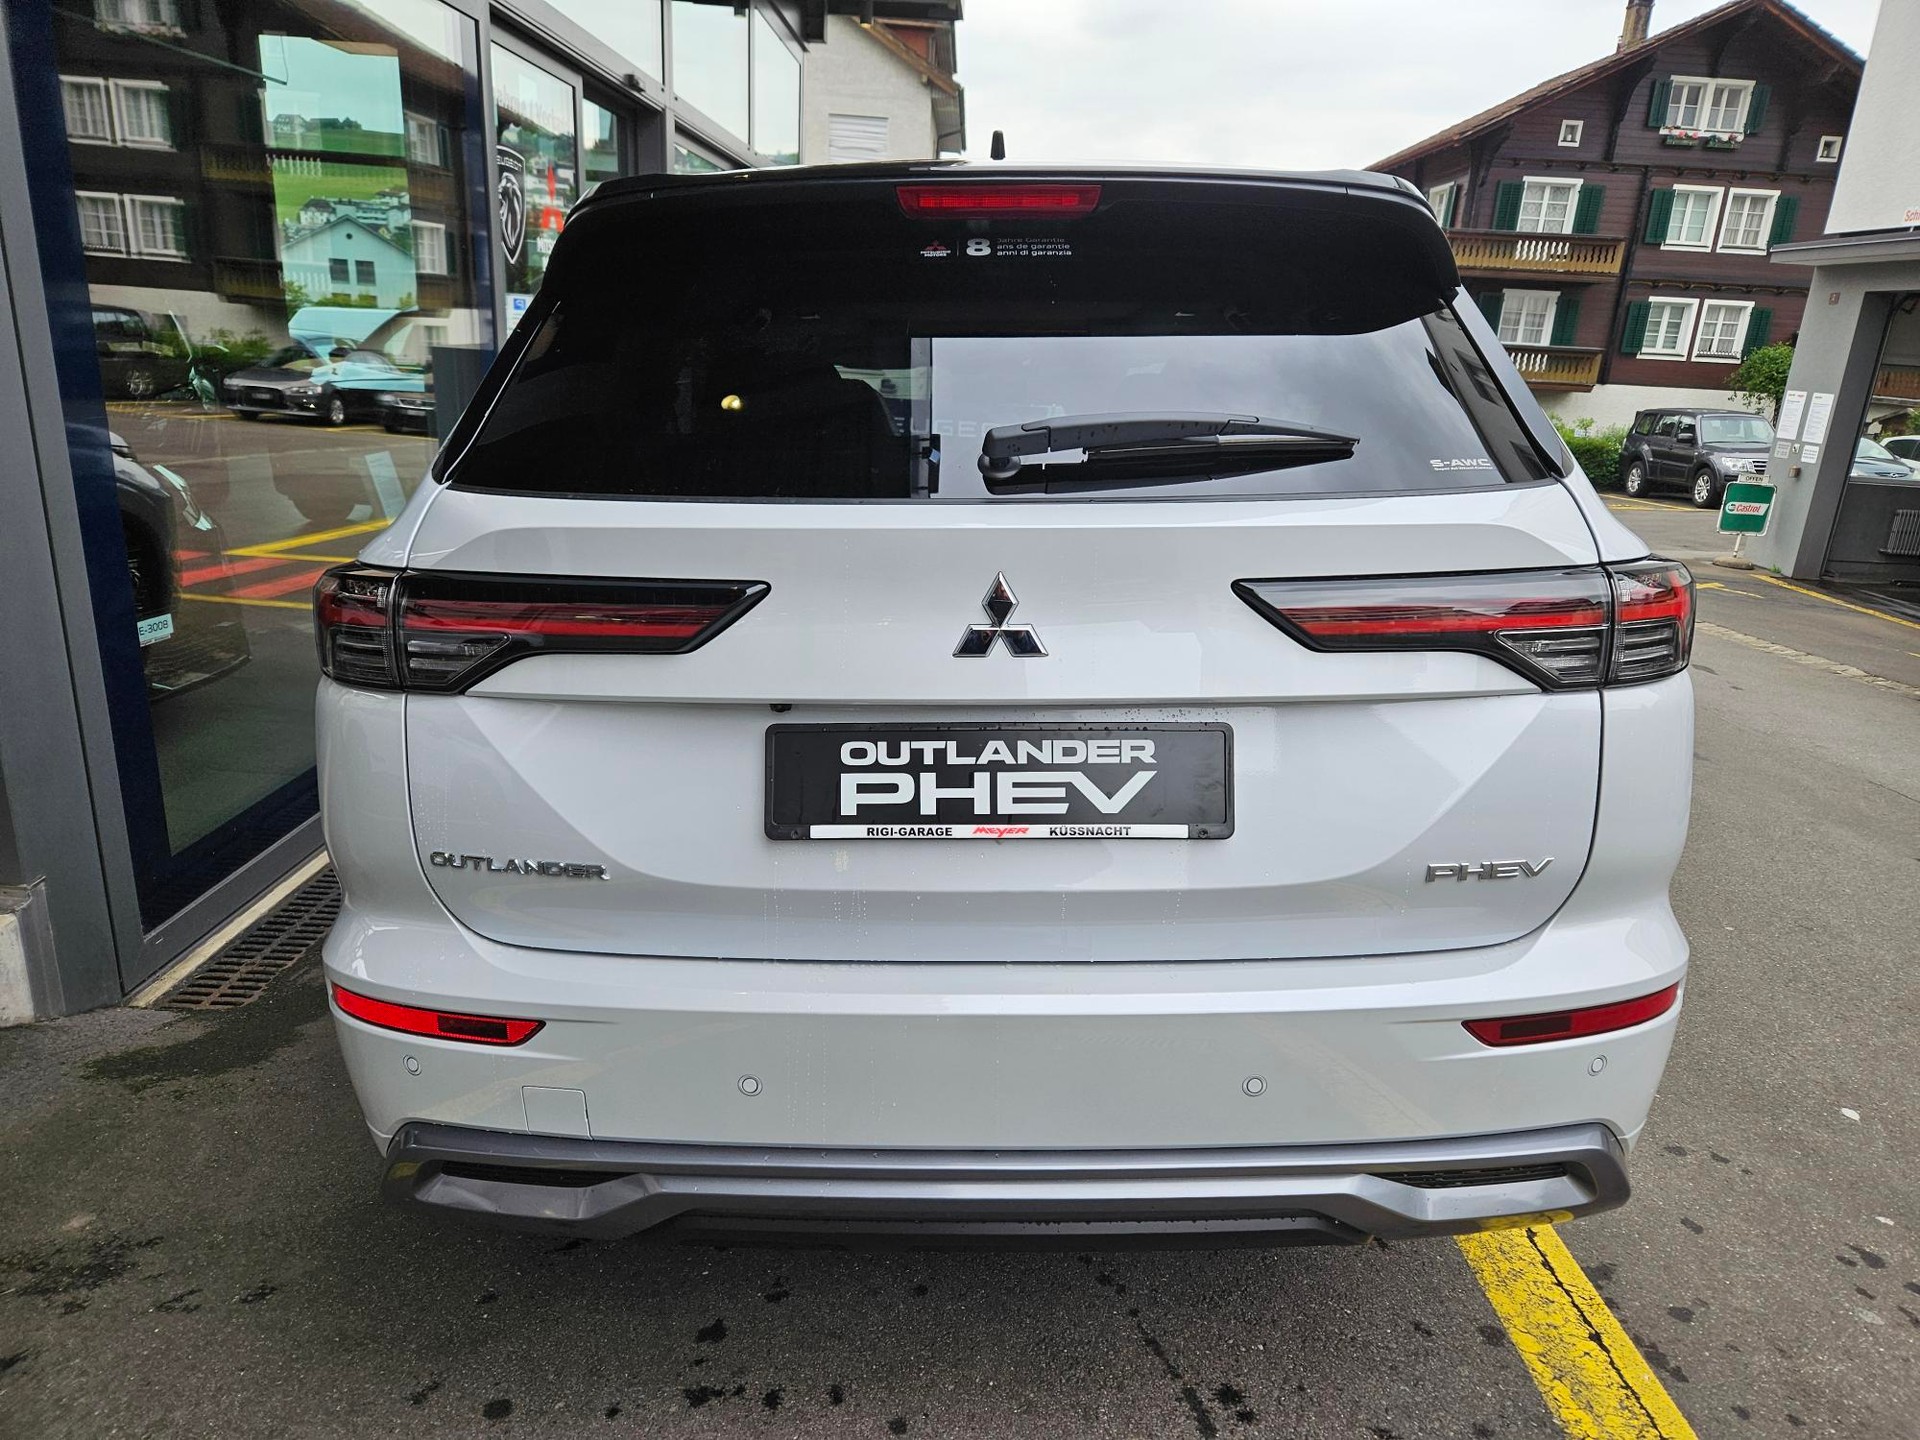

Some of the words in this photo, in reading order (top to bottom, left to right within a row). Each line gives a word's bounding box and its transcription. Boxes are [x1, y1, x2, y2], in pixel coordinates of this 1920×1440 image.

[496, 155, 523, 171] EUGEOT
[966, 238, 991, 256] 8
[1031, 243, 1070, 251] garantie
[1430, 458, 1491, 467] S-AWC
[1736, 504, 1761, 513] Castrol
[840, 739, 1158, 766] OUTLANDER
[840, 770, 1158, 816] PHEV
[866, 826, 953, 837] RIGI-GARAGE
[1049, 825, 1132, 837] KÜSSNACHT
[430, 851, 611, 881] OUTLANDER
[1425, 857, 1555, 883] PHEV
